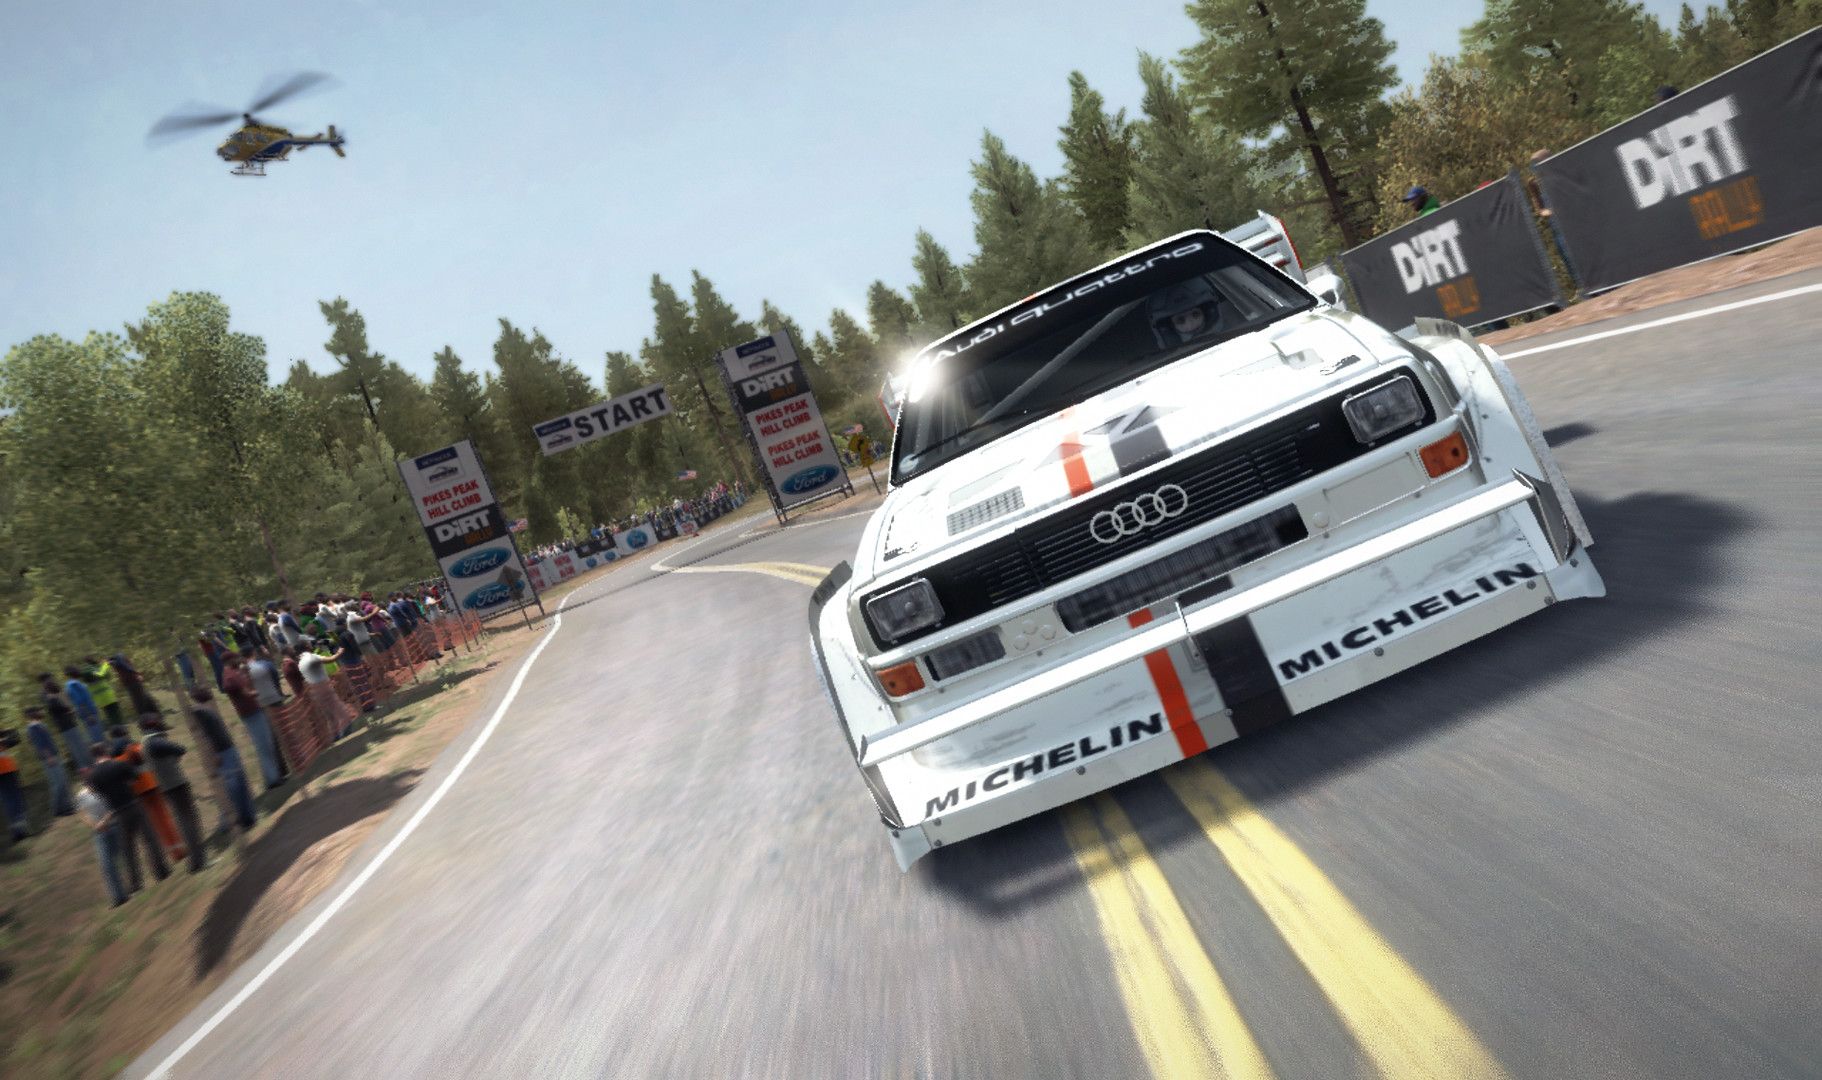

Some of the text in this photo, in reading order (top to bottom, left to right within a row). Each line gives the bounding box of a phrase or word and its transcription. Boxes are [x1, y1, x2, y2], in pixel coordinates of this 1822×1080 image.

[1010, 241, 1204, 327] quattro
[574, 387, 667, 438] START
[755, 398, 810, 425] PIKES PEAK
[760, 412, 812, 437] HILL CLIMB
[767, 430, 822, 457] PIKES PEAK
[772, 443, 824, 469] HILL CLIMB
[422, 479, 480, 507] PIKES PEAK
[793, 474, 828, 491] Ford
[427, 493, 482, 520] HILL CLIMB
[462, 553, 499, 575] Ford
[1277, 561, 1539, 682] MICHELIN
[922, 711, 1166, 822] MICHELIN
